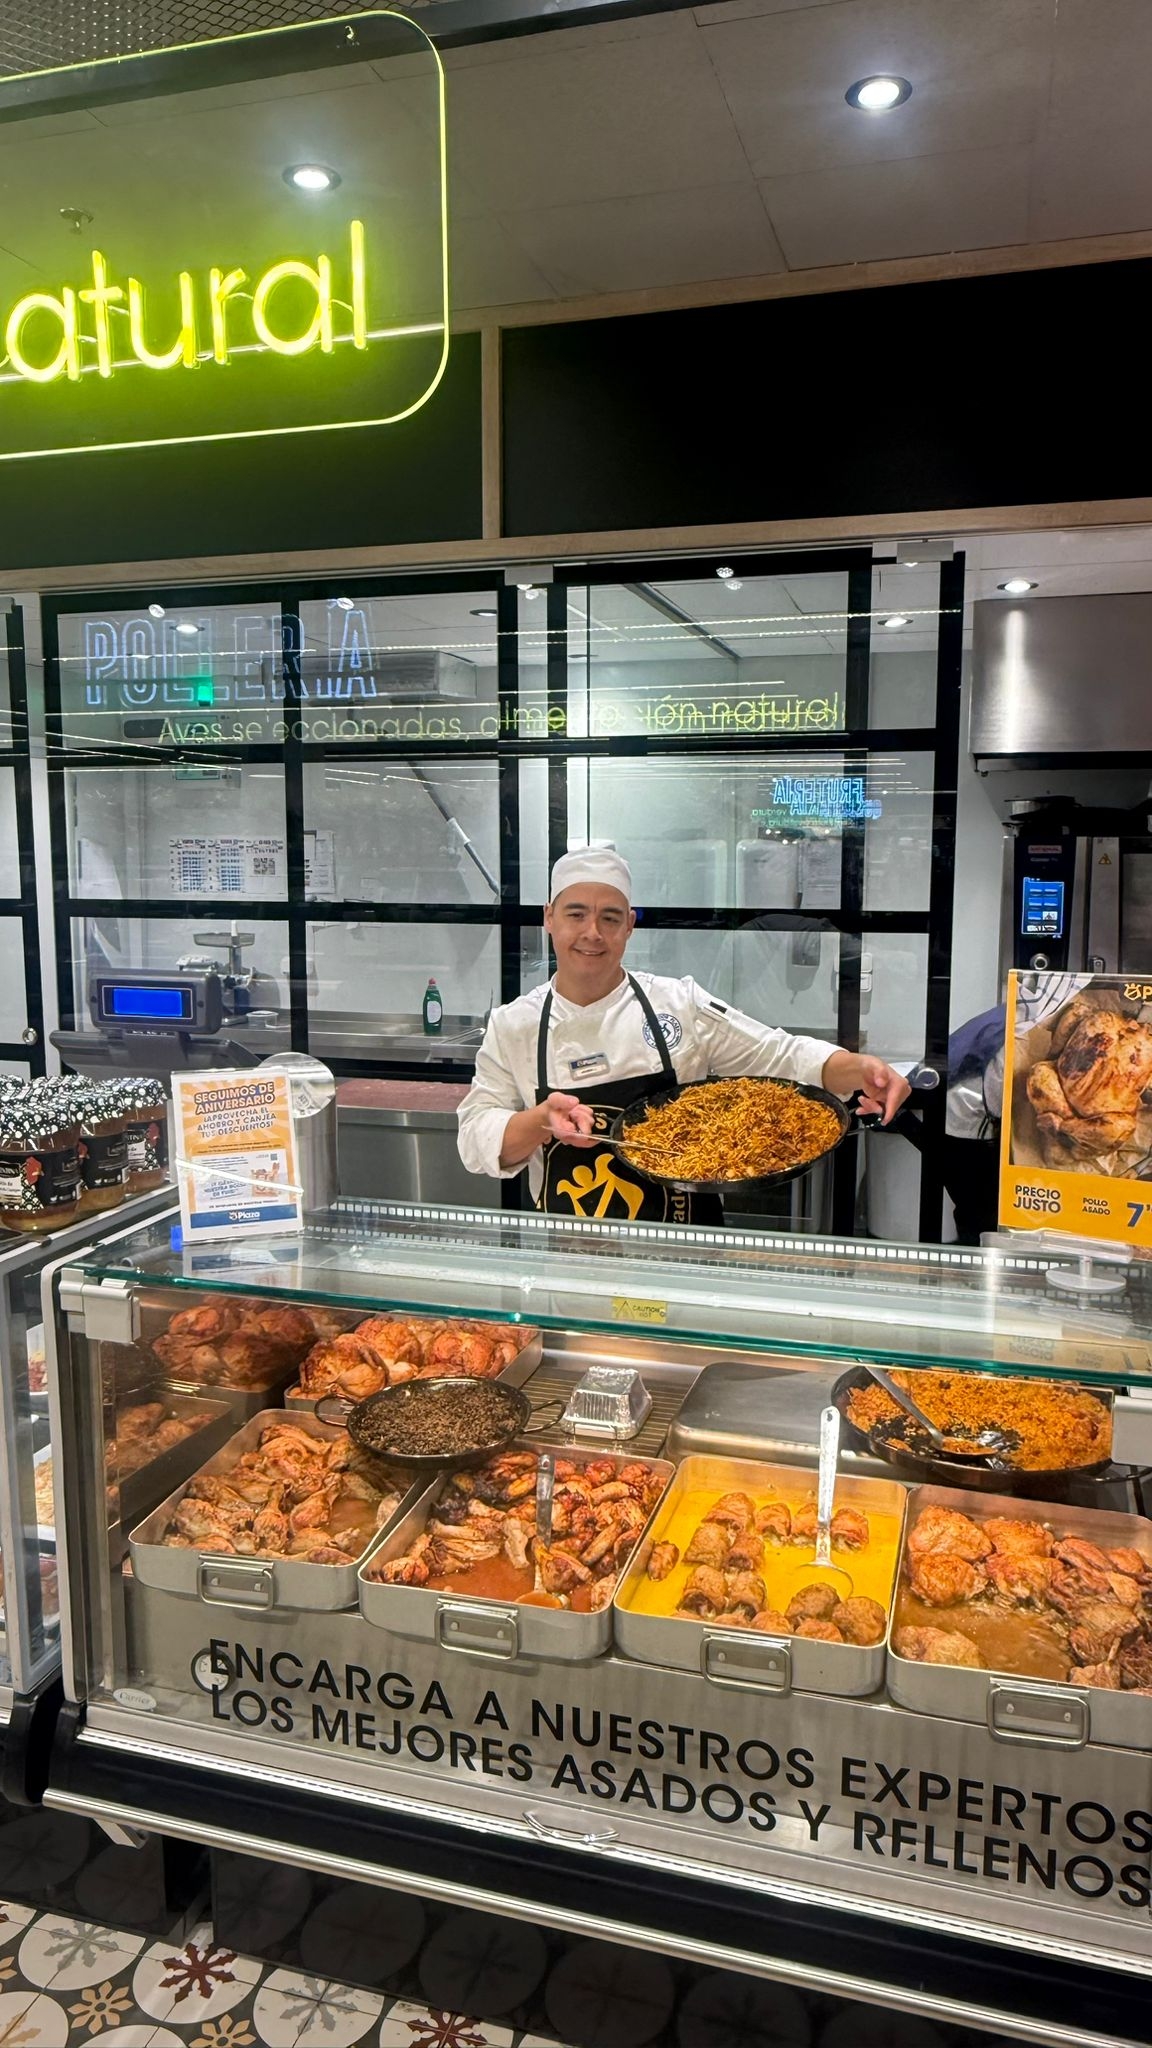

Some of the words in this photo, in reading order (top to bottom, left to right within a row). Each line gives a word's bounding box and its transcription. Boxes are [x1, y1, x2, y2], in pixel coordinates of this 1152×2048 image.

[6, 219, 367, 383] atural
[195, 1084, 257, 1103] SEGUIMOS
[258, 1082, 274, 1094] DE
[196, 1093, 275, 1114] ANIVERSARIO
[243, 1113, 277, 1124] CANJEA
[1015, 1185, 1061, 1200] PRECIO
[1013, 1197, 1062, 1213] JUSTO
[1082, 1206, 1111, 1216] ASADO
[1083, 1197, 1108, 1207] POLLO
[210, 1638, 453, 1719] ENCARGA
[474, 1690, 510, 1731] A
[532, 1698, 815, 1789] NUESTROS
[841, 1756, 1152, 1853] EXPERTOS
[211, 1684, 294, 1733] LOS
[312, 1704, 533, 1781] MEJORES
[551, 1754, 777, 1832] ASADOS
[798, 1799, 831, 1841] Y
[853, 1811, 1152, 1907] RELLENOS
